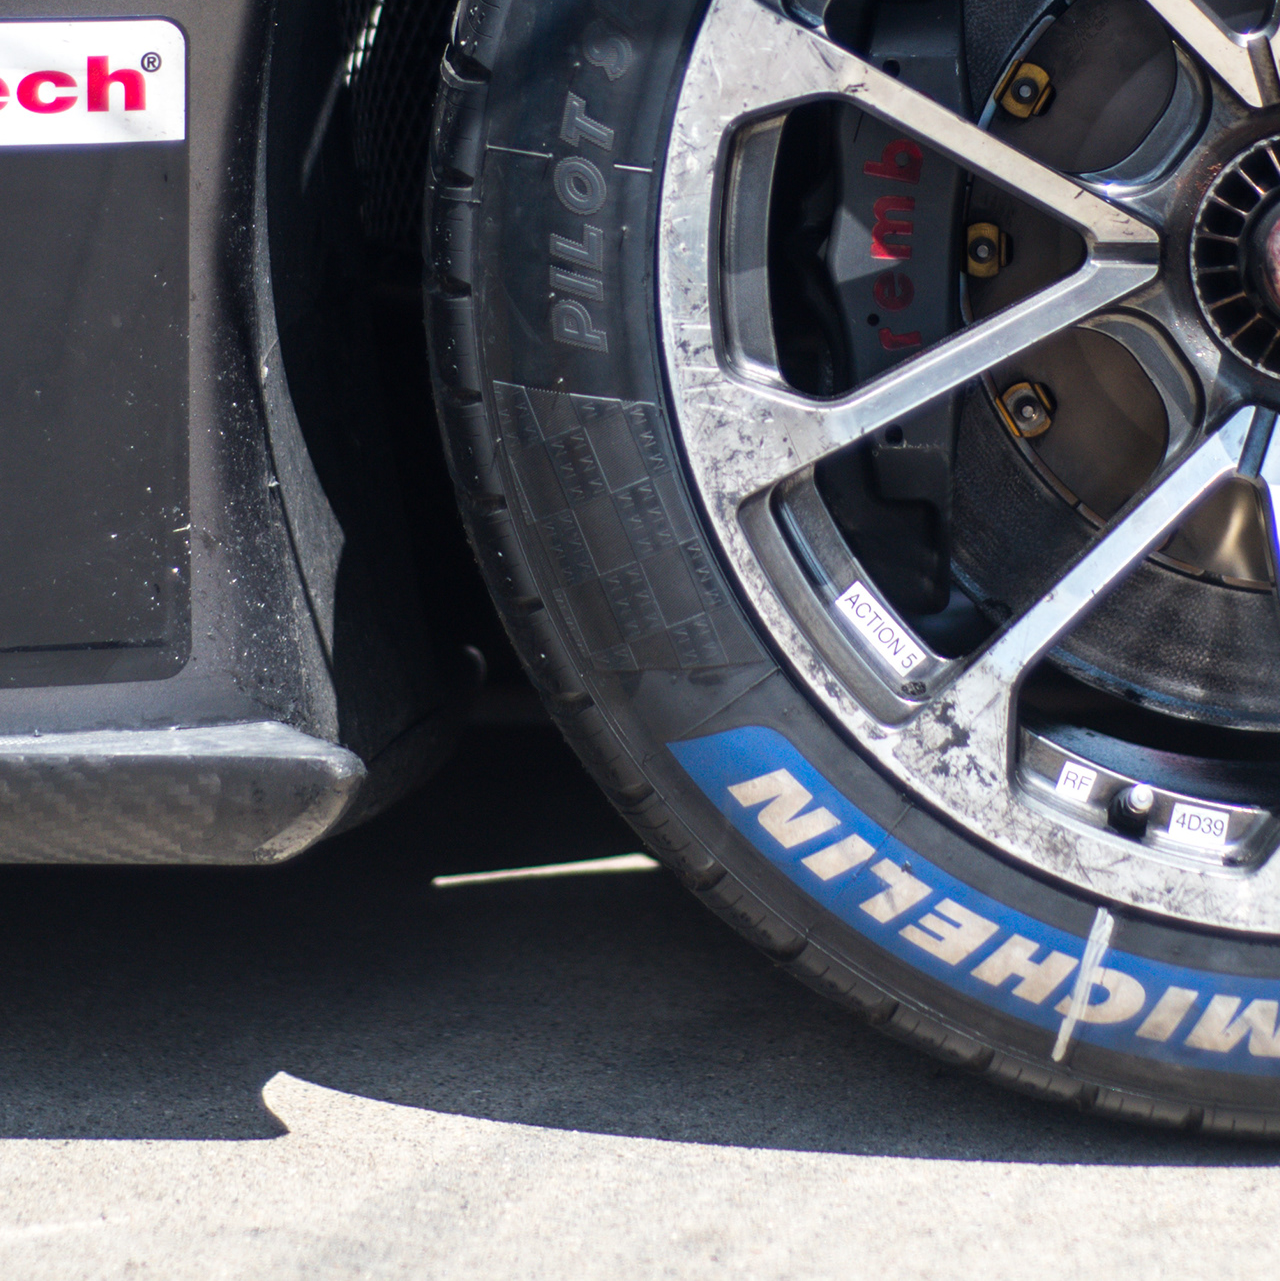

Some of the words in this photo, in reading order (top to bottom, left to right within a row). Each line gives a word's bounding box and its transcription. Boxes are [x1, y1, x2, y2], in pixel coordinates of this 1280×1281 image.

[549, 90, 615, 354] PILOT
[843, 593, 907, 657] ACTION
[900, 652, 918, 669] 5
[1062, 769, 1093, 792] RF
[1175, 811, 1226, 837] 4D39
